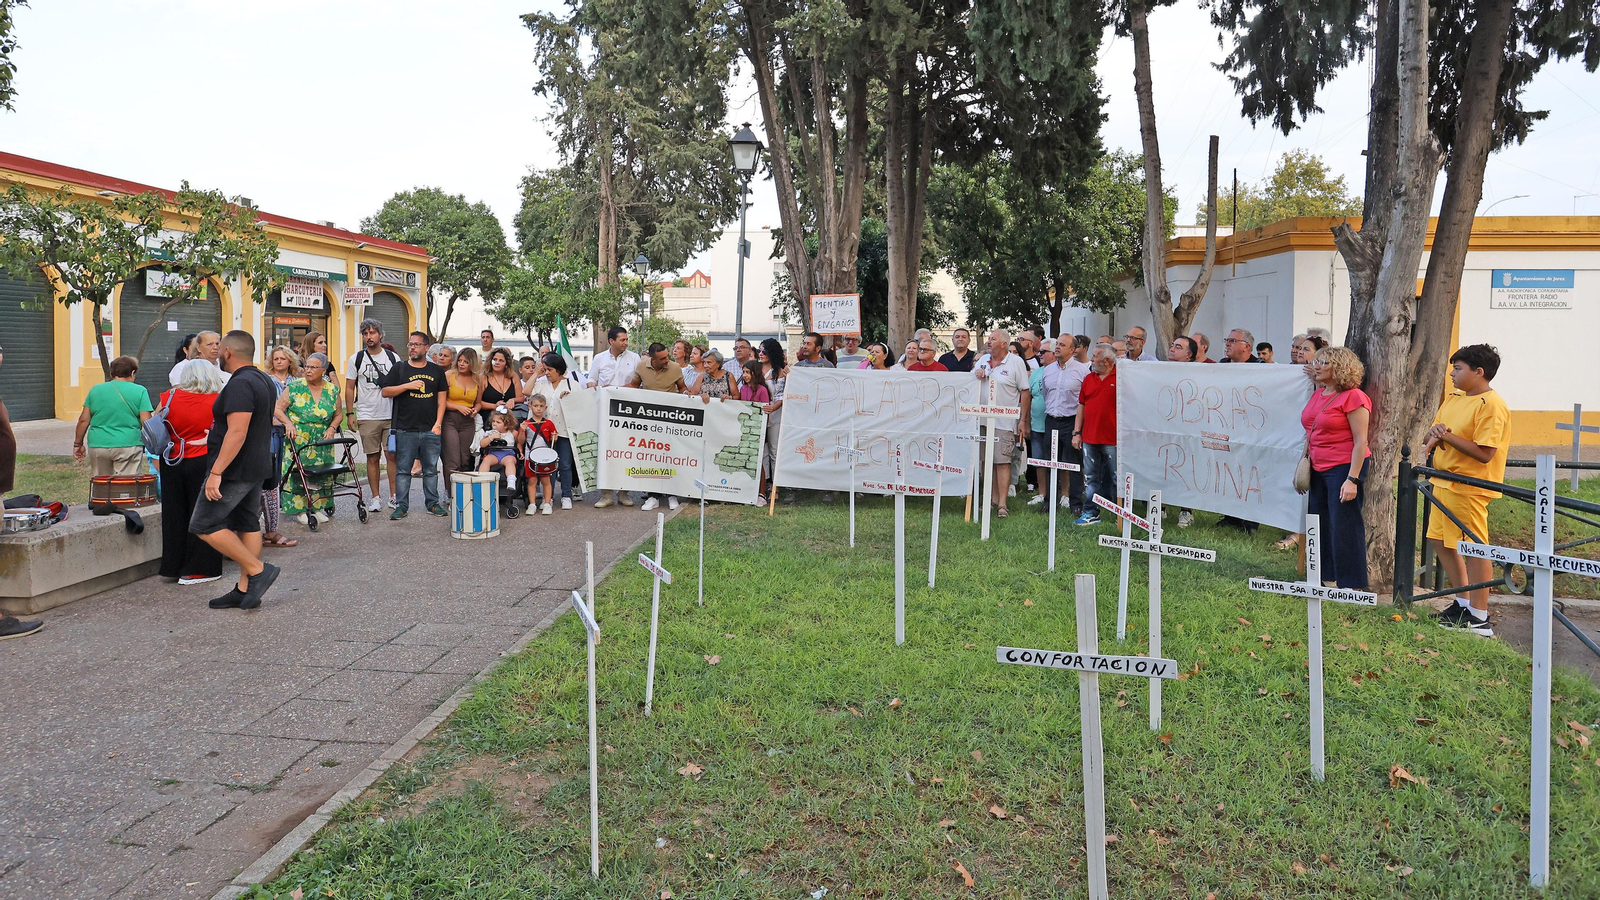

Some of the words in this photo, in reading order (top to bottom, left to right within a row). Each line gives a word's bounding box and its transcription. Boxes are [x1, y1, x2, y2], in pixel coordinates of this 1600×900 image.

[815, 300, 854, 309] MENTIRAS
[818, 319, 856, 330] ENGAÑOS
[408, 374, 434, 382] REFUGEES
[810, 376, 971, 423] PALABRAS
[1157, 378, 1268, 430] OBRAS
[618, 403, 632, 414] La
[636, 405, 695, 422] Asunción
[609, 419, 620, 428] 70
[622, 420, 648, 431] Años
[650, 424, 664, 433] de
[666, 426, 702, 438] historia
[628, 436, 636, 446] 2
[638, 437, 670, 451] Años
[834, 435, 938, 470] HECHOS
[606, 449, 632, 460] para
[636, 451, 698, 468] arruinarla
[628, 468, 658, 476] ¡Solución
[660, 468, 672, 476] YA!
[946, 466, 962, 474] PIEDAD
[1158, 442, 1262, 504] RUINA
[896, 484, 906, 492] LOS
[908, 486, 936, 494] REMEDIOS
[1114, 506, 1122, 516] DEL
[1150, 494, 1158, 540] CALLE
[1539, 486, 1548, 534] CALLE
[1102, 538, 1128, 548] NUESTRA
[1150, 544, 1163, 553] DEL
[1168, 548, 1212, 560] DESAMPARO
[1308, 527, 1316, 570] CALLE
[1520, 552, 1544, 566] DEL
[1252, 581, 1284, 592] NUESTRA
[1312, 588, 1324, 596] DE
[1327, 590, 1374, 604] GUADALUPE
[1006, 650, 1166, 676] CONFORTACION
